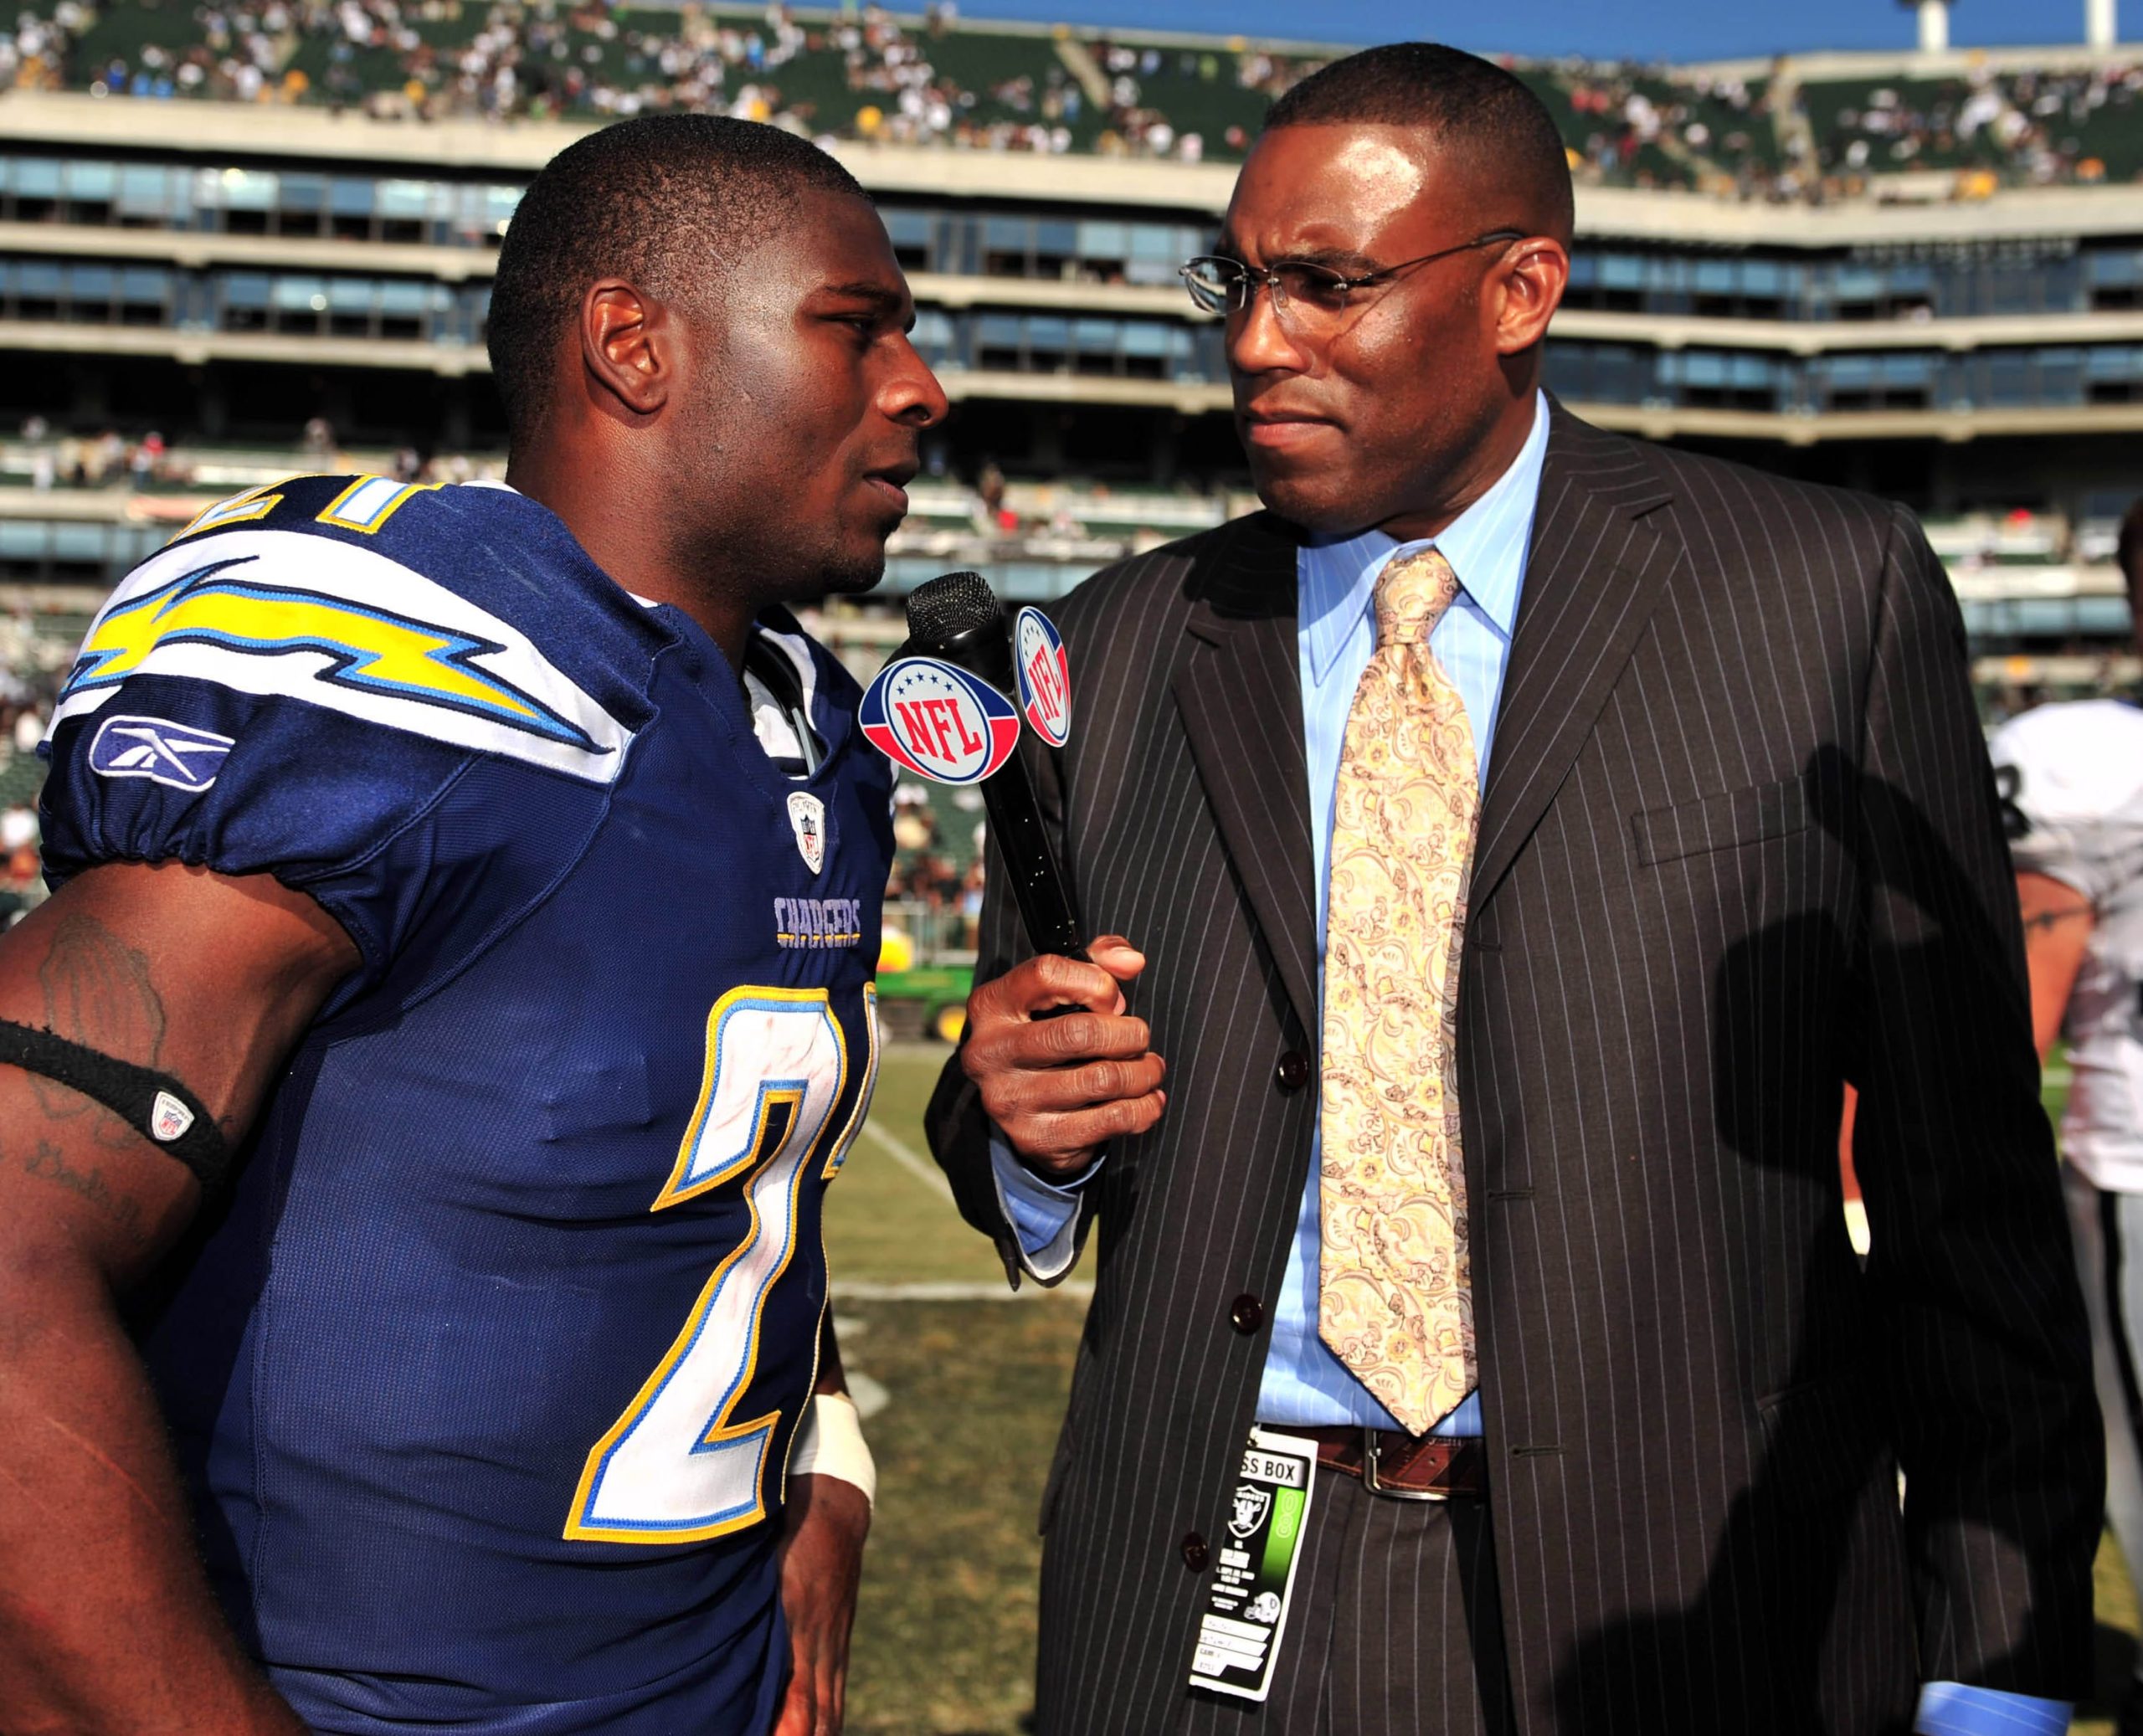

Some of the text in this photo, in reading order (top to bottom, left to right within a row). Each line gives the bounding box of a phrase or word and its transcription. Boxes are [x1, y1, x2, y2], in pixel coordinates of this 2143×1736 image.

[1028, 644, 1062, 721] NFL
[894, 698, 984, 764] NFL
[563, 982, 881, 1545] 2
[1265, 1461, 1295, 1482] BOX
